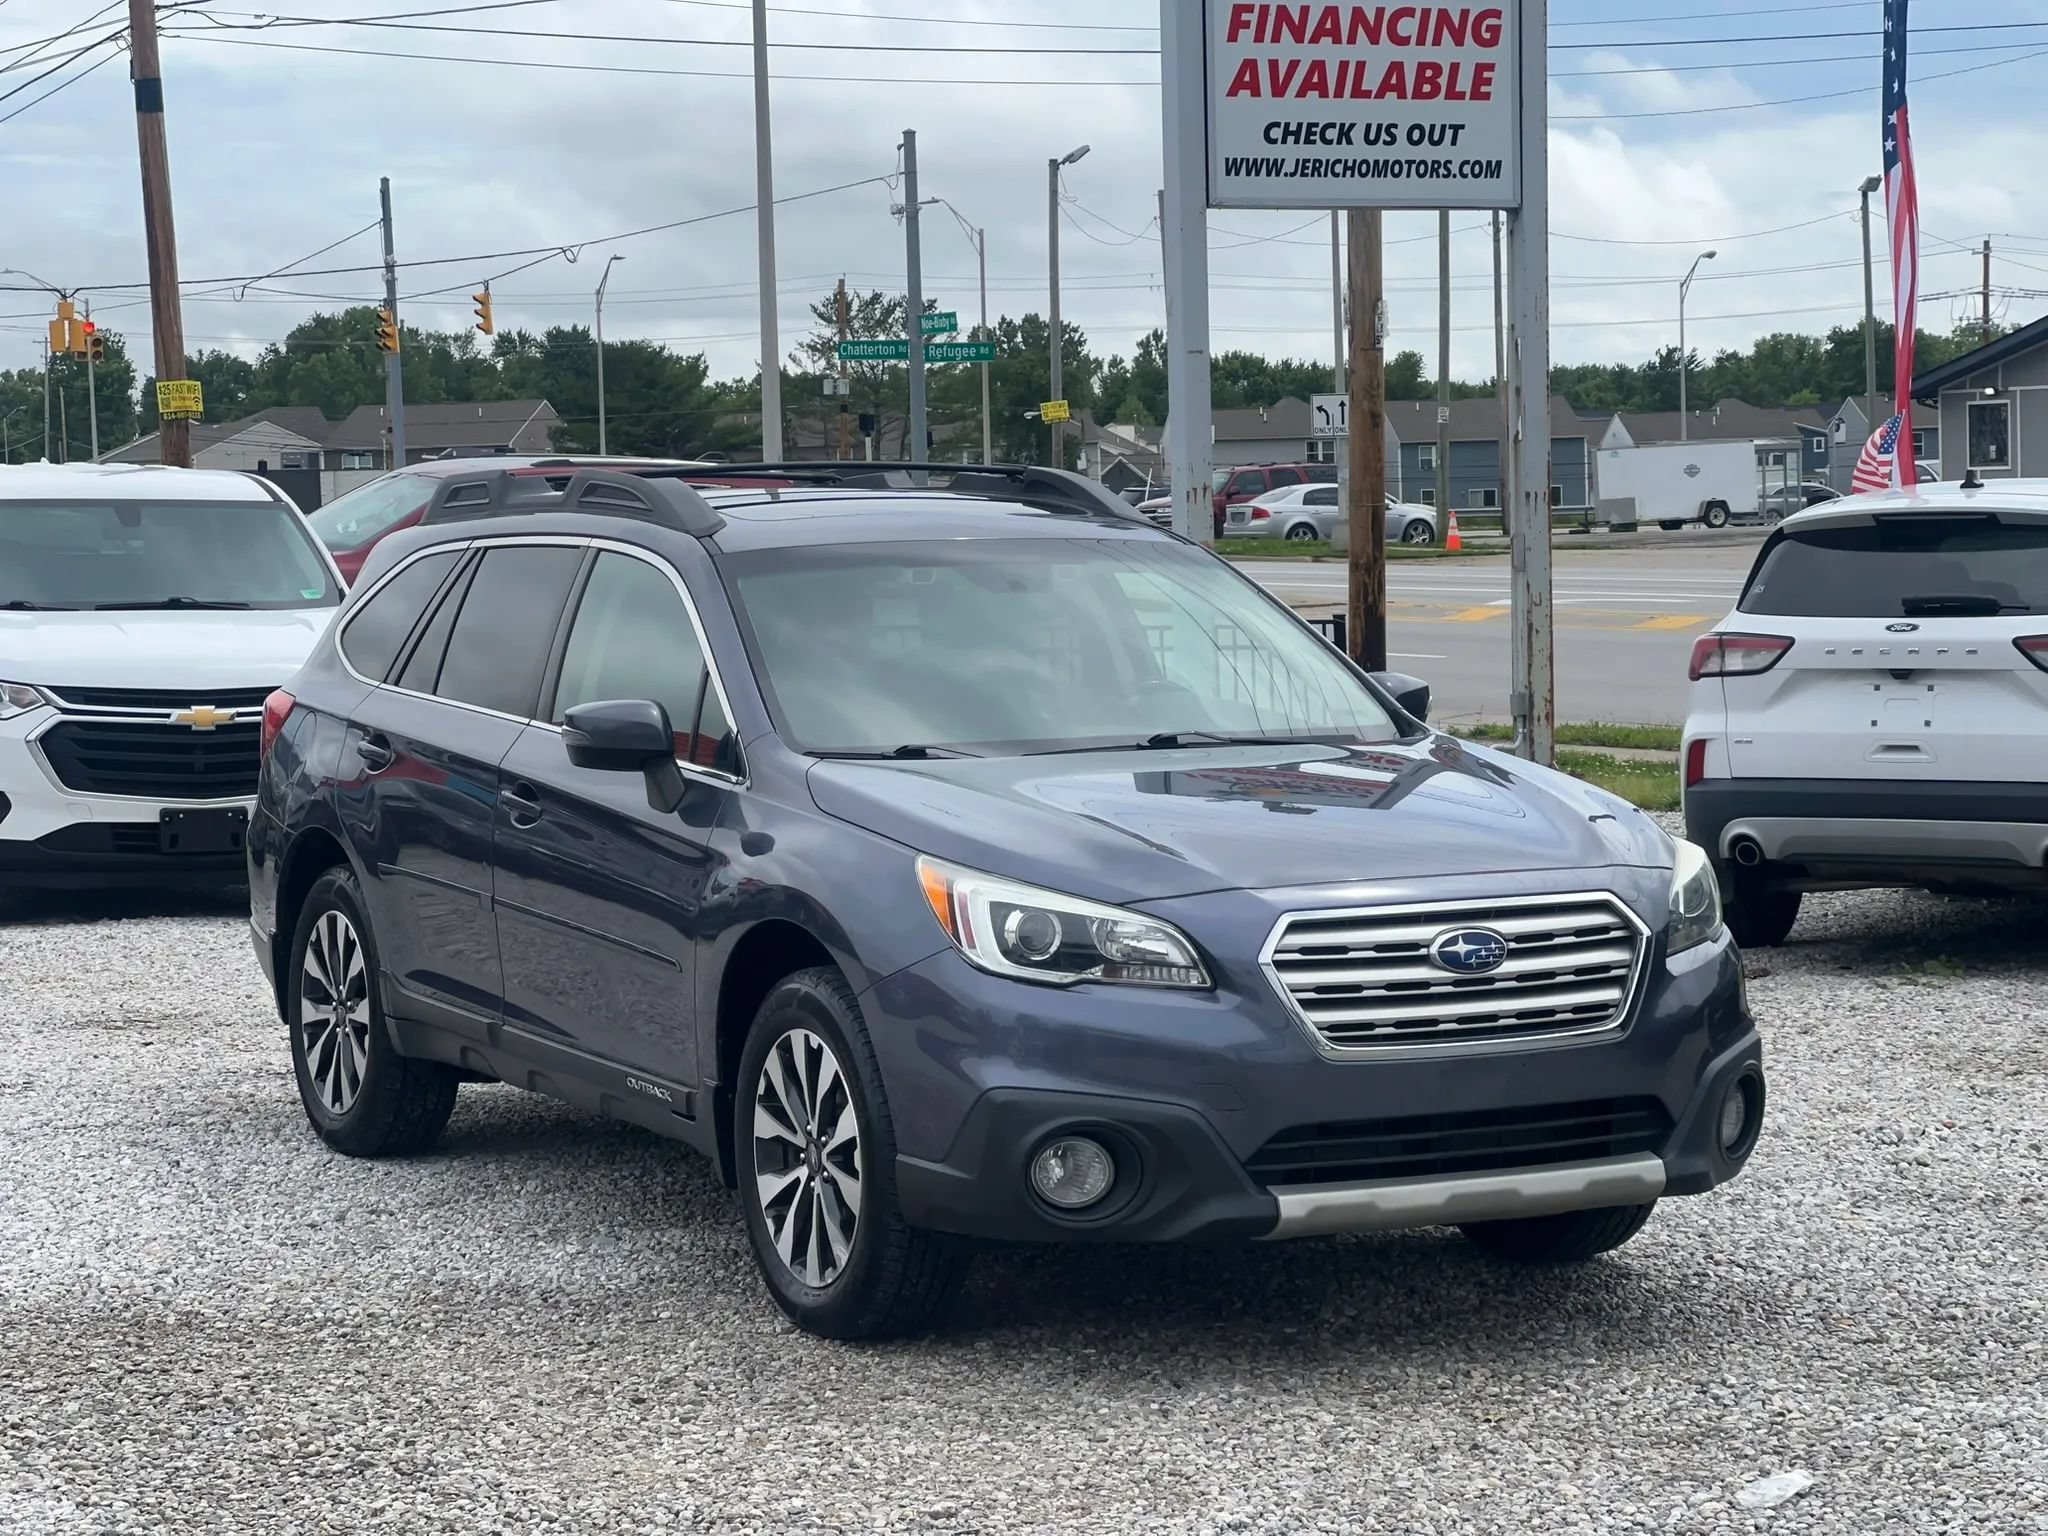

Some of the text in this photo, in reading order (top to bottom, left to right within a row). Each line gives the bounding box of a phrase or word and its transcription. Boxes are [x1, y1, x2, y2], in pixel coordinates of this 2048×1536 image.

[1226, 3, 1503, 49] FINANCING
[1225, 58, 1497, 101] AVAILABLE
[1263, 121, 1466, 147] CHECK US OUT
[1224, 156, 1503, 180] WWW.JERICHOMOTORS.COM
[840, 343, 907, 356] Chatterton Rd
[928, 346, 990, 361] Refugee Rd
[172, 383, 186, 394] FAST
[1314, 426, 1333, 435] ONLY
[1334, 426, 1349, 435] ONL
[1890, 623, 1914, 631] Ford
[626, 1076, 673, 1103] OUTBACK
